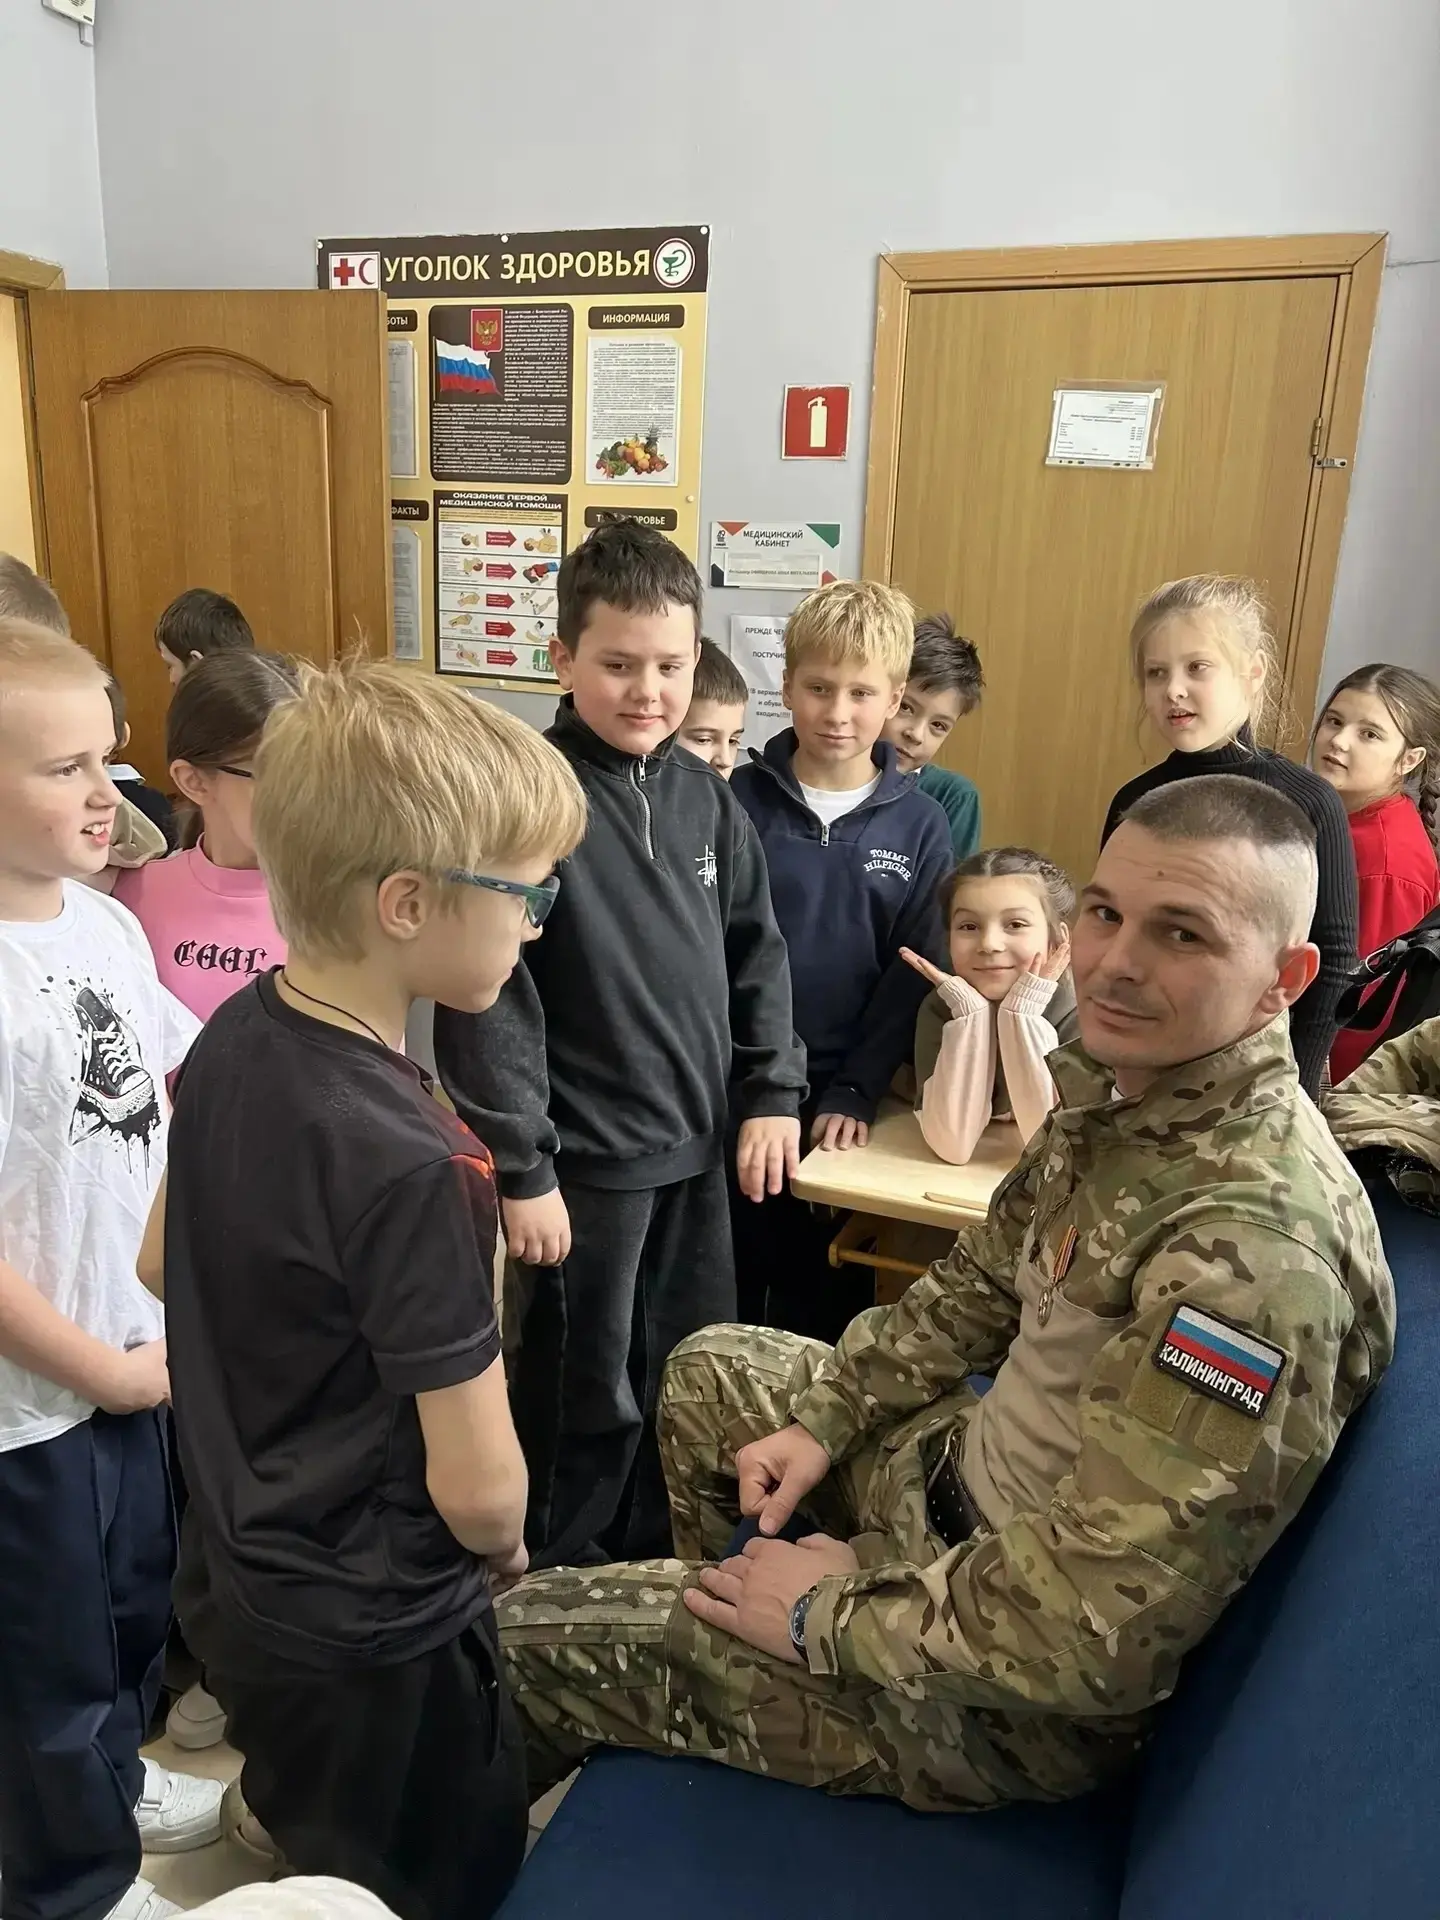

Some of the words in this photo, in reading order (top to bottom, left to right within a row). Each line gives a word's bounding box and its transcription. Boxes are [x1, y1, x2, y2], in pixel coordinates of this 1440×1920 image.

[384, 253, 491, 283] УГОЛОК
[500, 248, 651, 283] ЗДОРОВЬЯ
[601, 311, 671, 325] ИНФОРМАЦИЯ
[452, 492, 505, 501] ОКАЗАНИЕ
[507, 493, 548, 502] ПЕРВОЙ
[391, 506, 420, 515] ФАКТЫ
[439, 499, 514, 508] МЕДИЦИНСКОЙ
[515, 502, 562, 510] ПОМОЩИ
[743, 529, 804, 540] МЕДИЦИНСКИЙ
[754, 539, 791, 548] КАБИНЕТ
[745, 627, 773, 636] ПРЕЖДЕ
[869, 848, 911, 864] TOMMY
[863, 859, 912, 882] HILFIGER
[174, 939, 268, 978] COOL
[1157, 1343, 1264, 1413] КАЛИНИНГРАД
